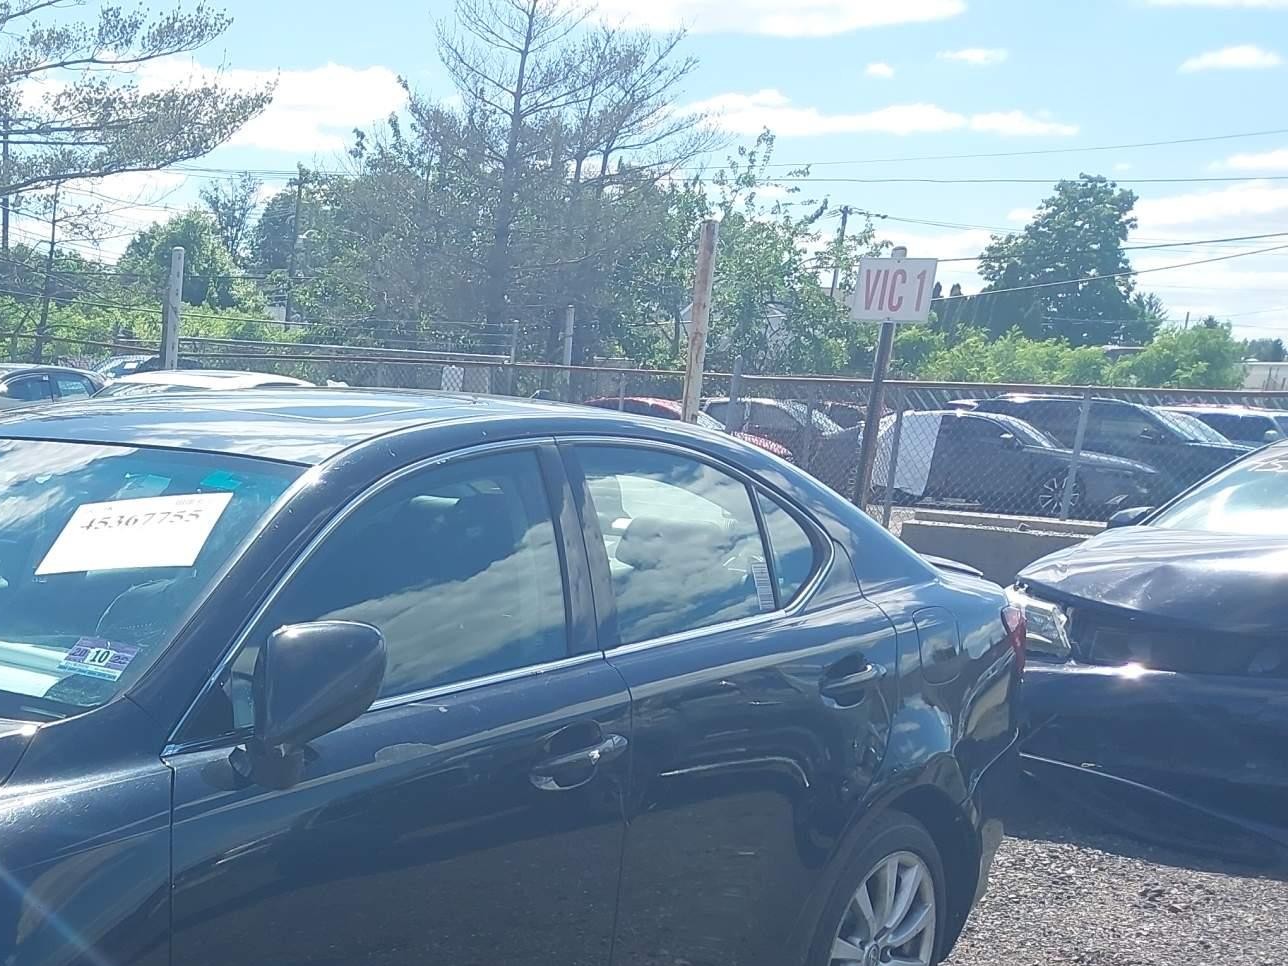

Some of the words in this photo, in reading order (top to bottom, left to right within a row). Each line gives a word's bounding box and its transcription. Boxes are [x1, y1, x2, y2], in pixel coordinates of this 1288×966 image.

[864, 268, 907, 313] VIC
[915, 269, 927, 313] 1
[80, 509, 204, 532] 45367755
[90, 649, 111, 663] 10
